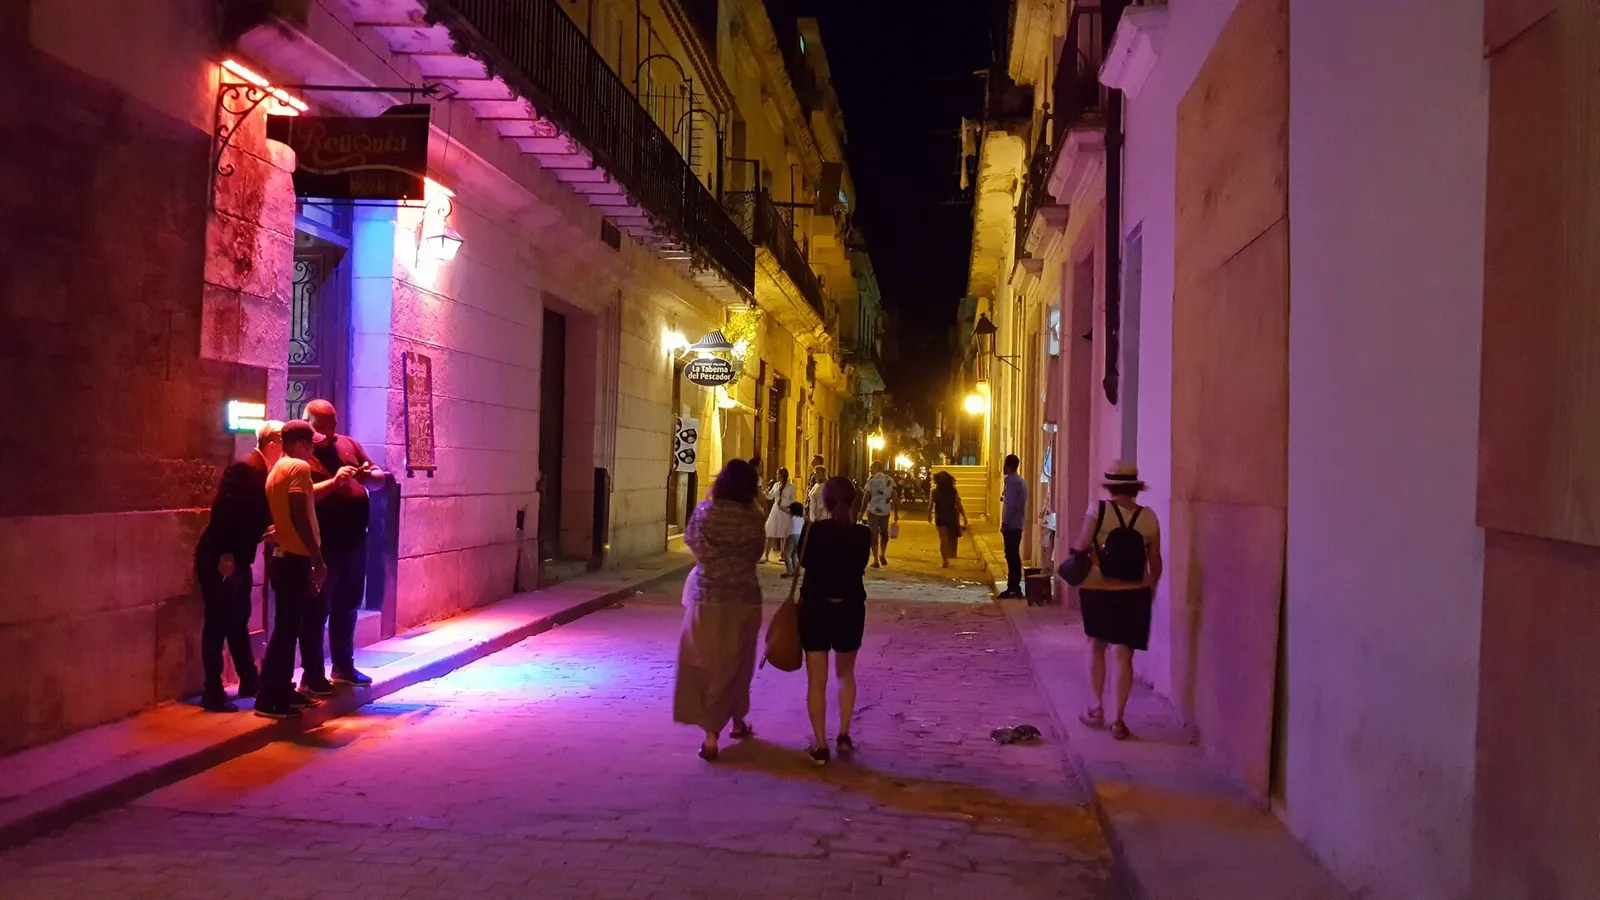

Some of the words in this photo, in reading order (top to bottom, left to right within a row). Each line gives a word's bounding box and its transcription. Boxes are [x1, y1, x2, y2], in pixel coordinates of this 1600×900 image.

[692, 365, 700, 373] La
[701, 365, 729, 373] Taberna
[688, 372, 699, 380] del
[700, 372, 731, 380] Pescador
